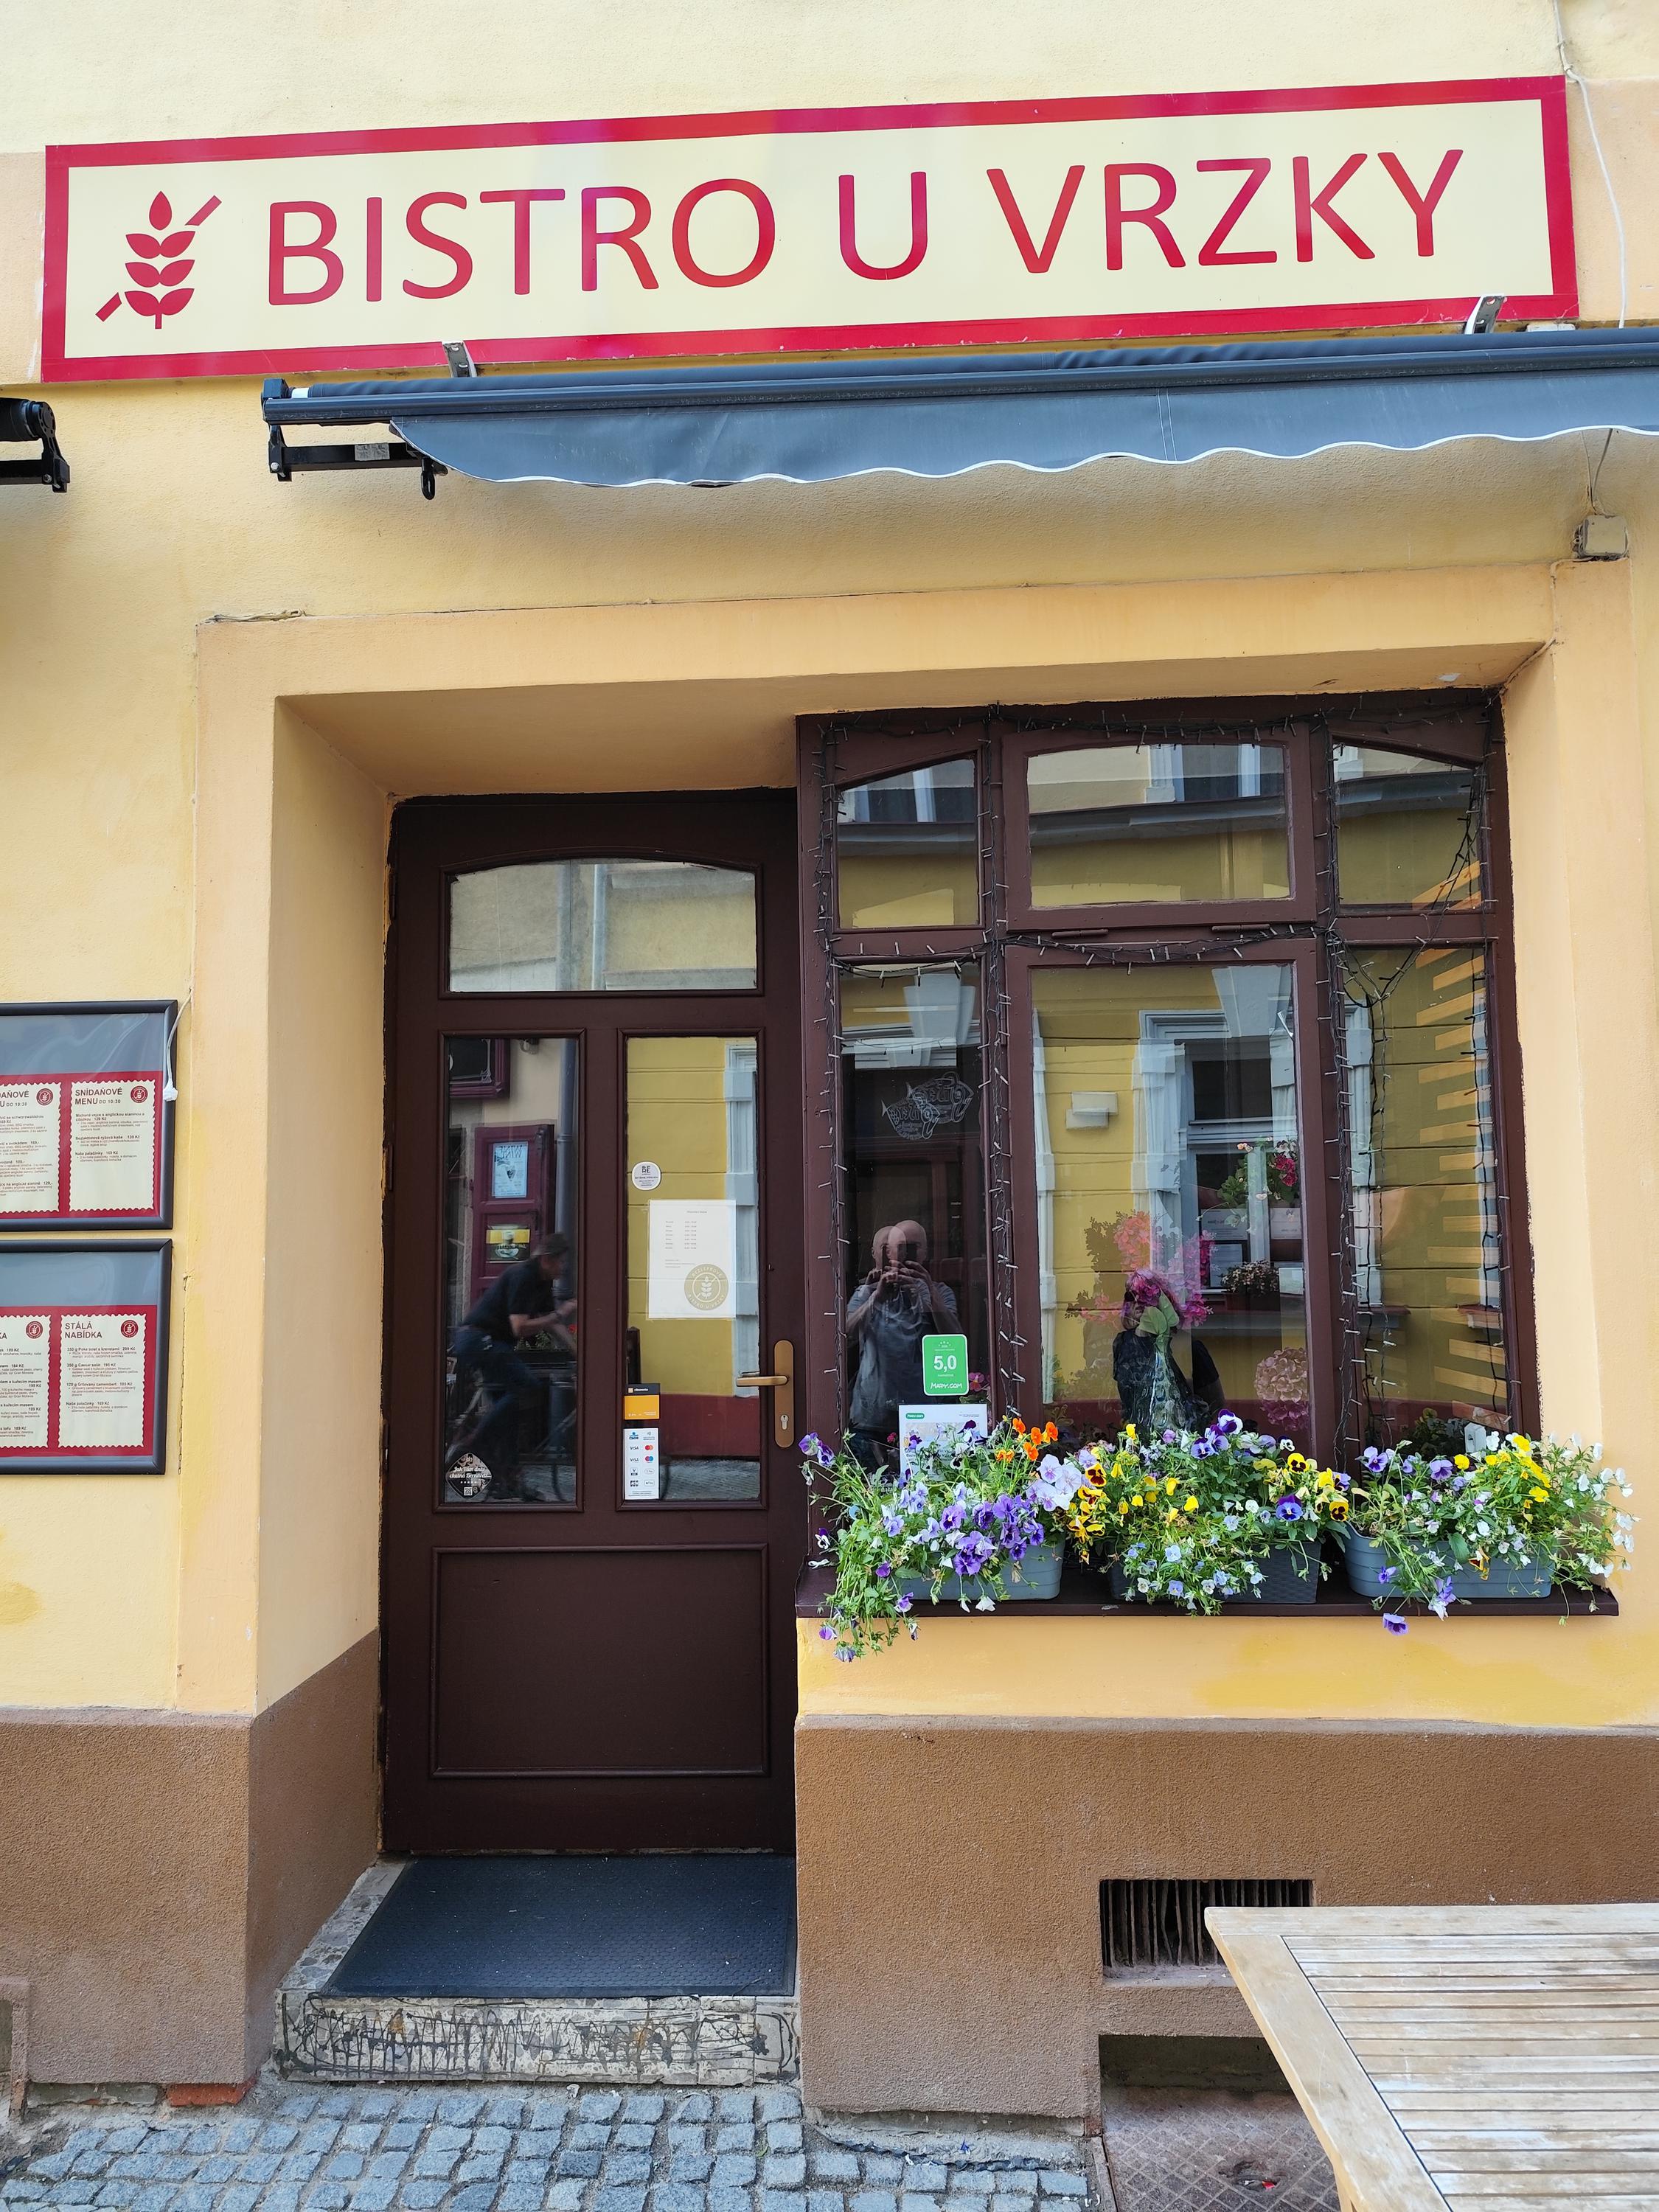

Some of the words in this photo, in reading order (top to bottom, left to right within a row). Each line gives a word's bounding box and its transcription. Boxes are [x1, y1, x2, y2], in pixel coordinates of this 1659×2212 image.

[269, 179, 775, 305] BISTRO
[839, 172, 928, 280] U
[987, 150, 1463, 273] VRZKY
[0, 1090, 29, 1098] AŇOVÉ
[75, 1087, 122, 1096] SNÍDAŇOVÉ
[65, 1321, 92, 1329] STÁLÁ
[933, 1355, 957, 1372] 5,0
